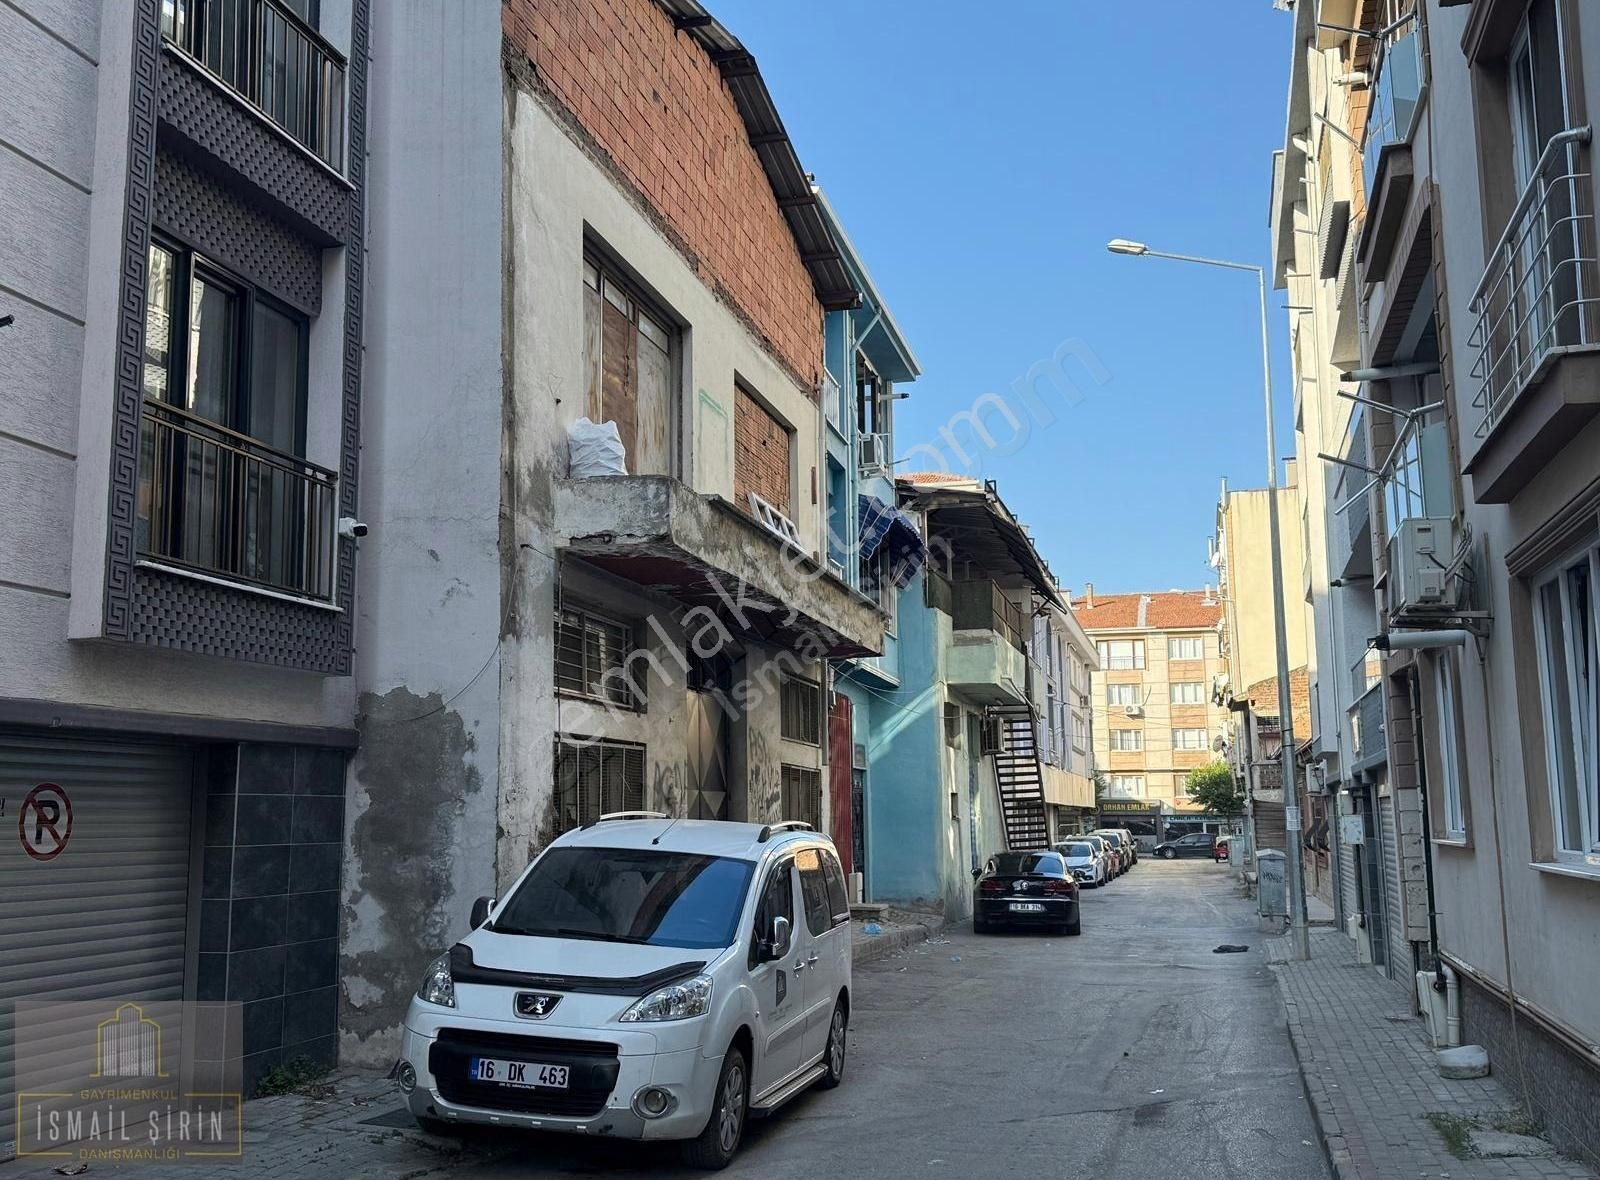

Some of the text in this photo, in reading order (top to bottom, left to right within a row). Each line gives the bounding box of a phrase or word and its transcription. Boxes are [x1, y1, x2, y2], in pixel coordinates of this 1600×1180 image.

[480, 1060, 495, 1079] 16
[507, 1063, 526, 1082] DK
[538, 1066, 567, 1086] 463
